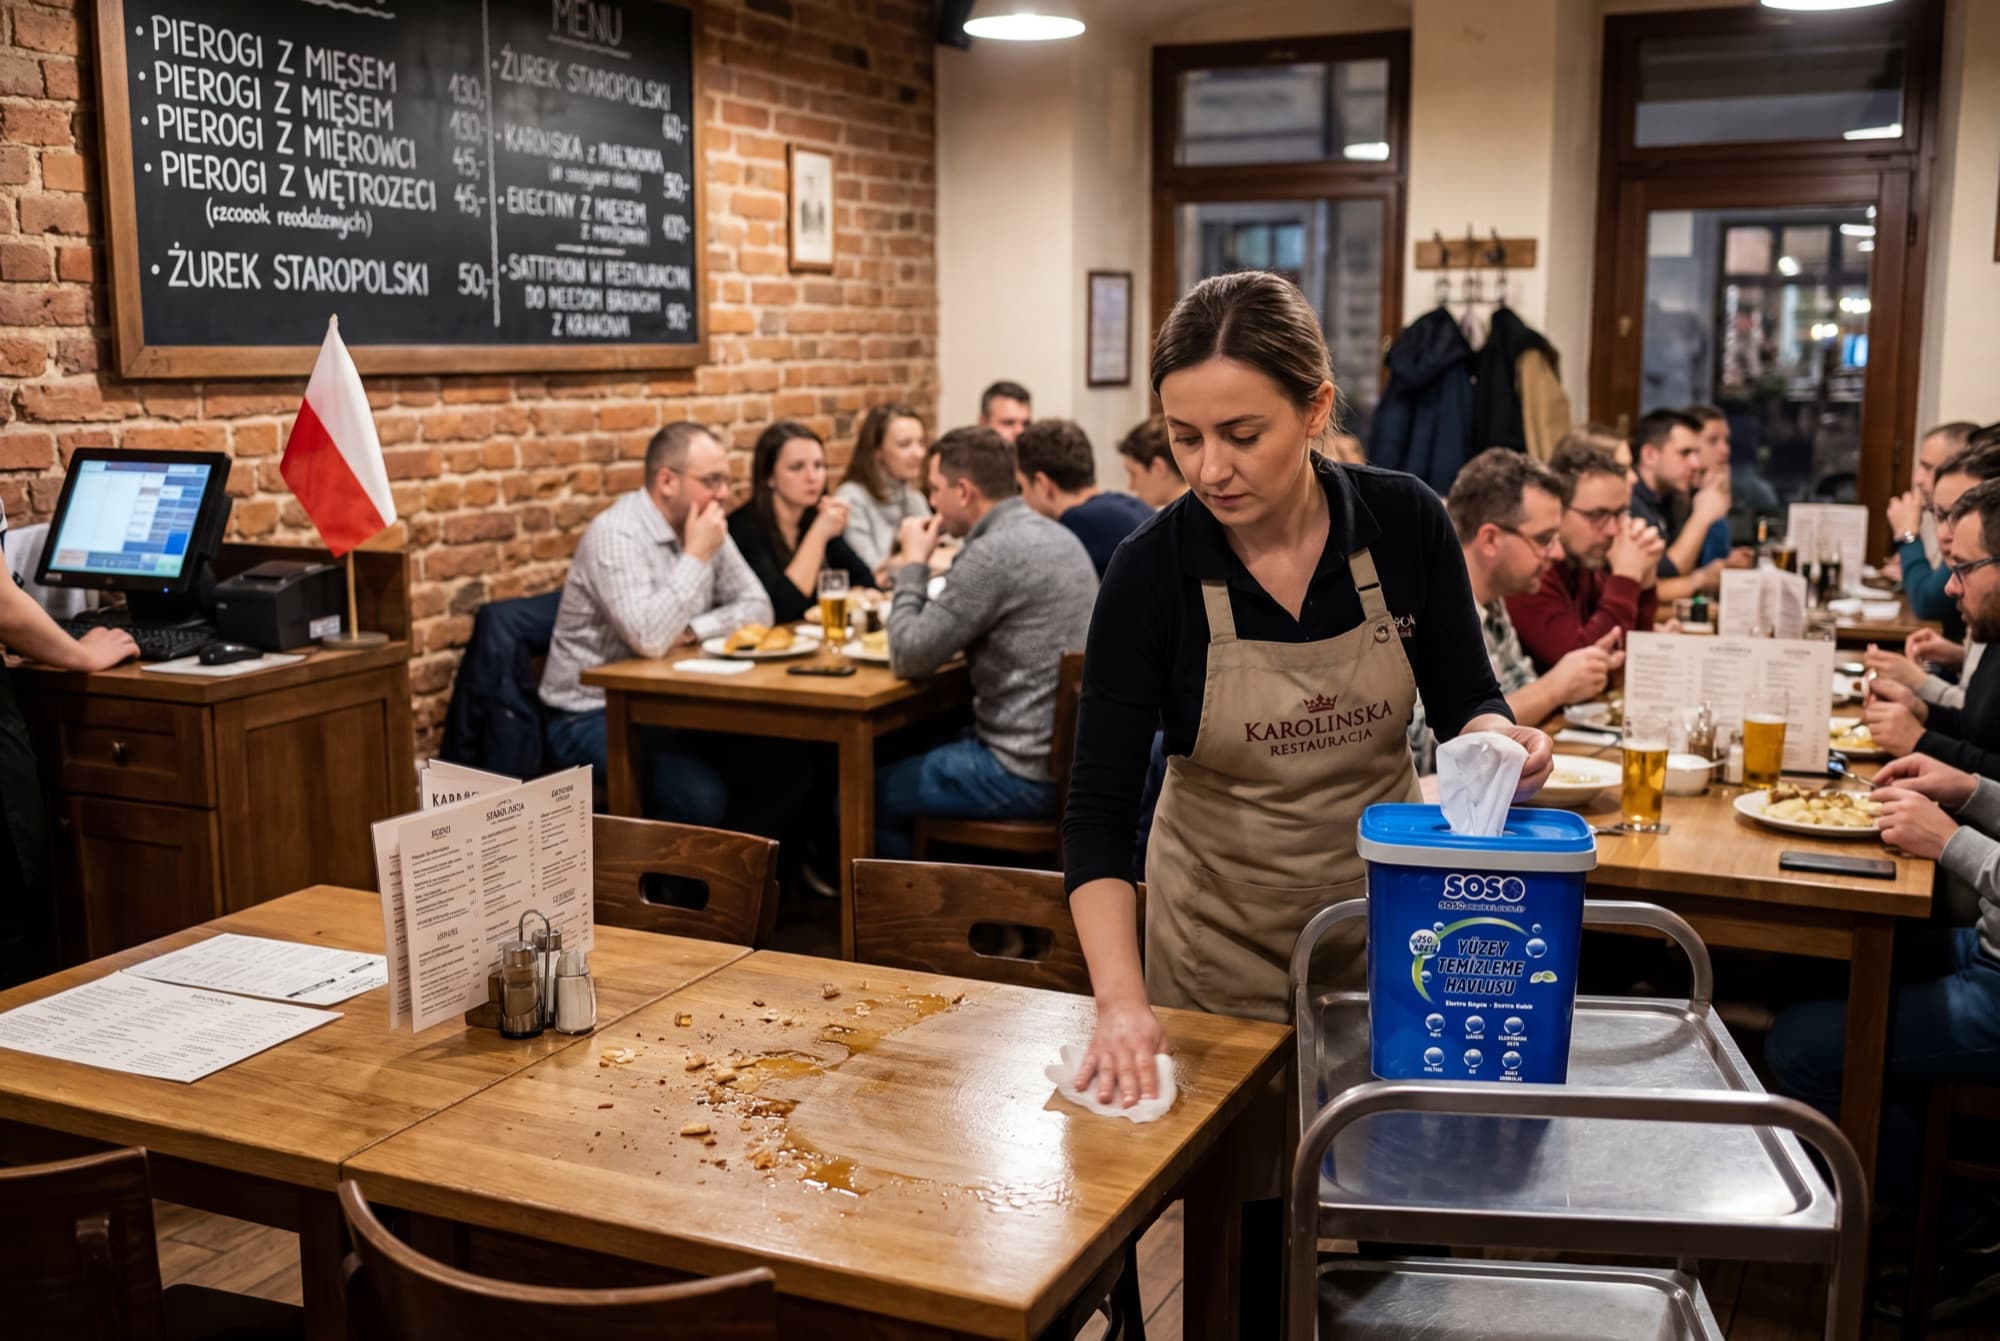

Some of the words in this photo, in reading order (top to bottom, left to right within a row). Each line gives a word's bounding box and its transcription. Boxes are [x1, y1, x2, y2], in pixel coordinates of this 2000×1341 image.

[552, 0, 623, 46] MENU
[151, 14, 264, 70] PIEROGI
[276, 39, 295, 75] Z
[305, 45, 397, 93] MIĘSEM
[154, 60, 262, 111] PIEROGI
[273, 80, 292, 115] Z
[301, 85, 395, 131] MIĘSEM
[567, 63, 671, 111] STAROPOLSKI
[157, 103, 264, 151] PIEROGI
[276, 120, 295, 155] Z
[303, 124, 417, 170] MIĘROWCI
[161, 150, 268, 195] PIEROGI
[278, 163, 296, 198] Z
[167, 241, 262, 290] ŻUREK
[273, 253, 430, 296] STAROPOLSKI
[1244, 700, 1393, 743] KAROLINSKA
[1270, 728, 1373, 757] RESTAURACJA
[1443, 873, 1526, 903] SOSO
[1437, 955, 1526, 977] TEMİZLEME
[1458, 936, 1510, 957] YÜZEY
[1444, 977, 1517, 997] HAVLUSU
